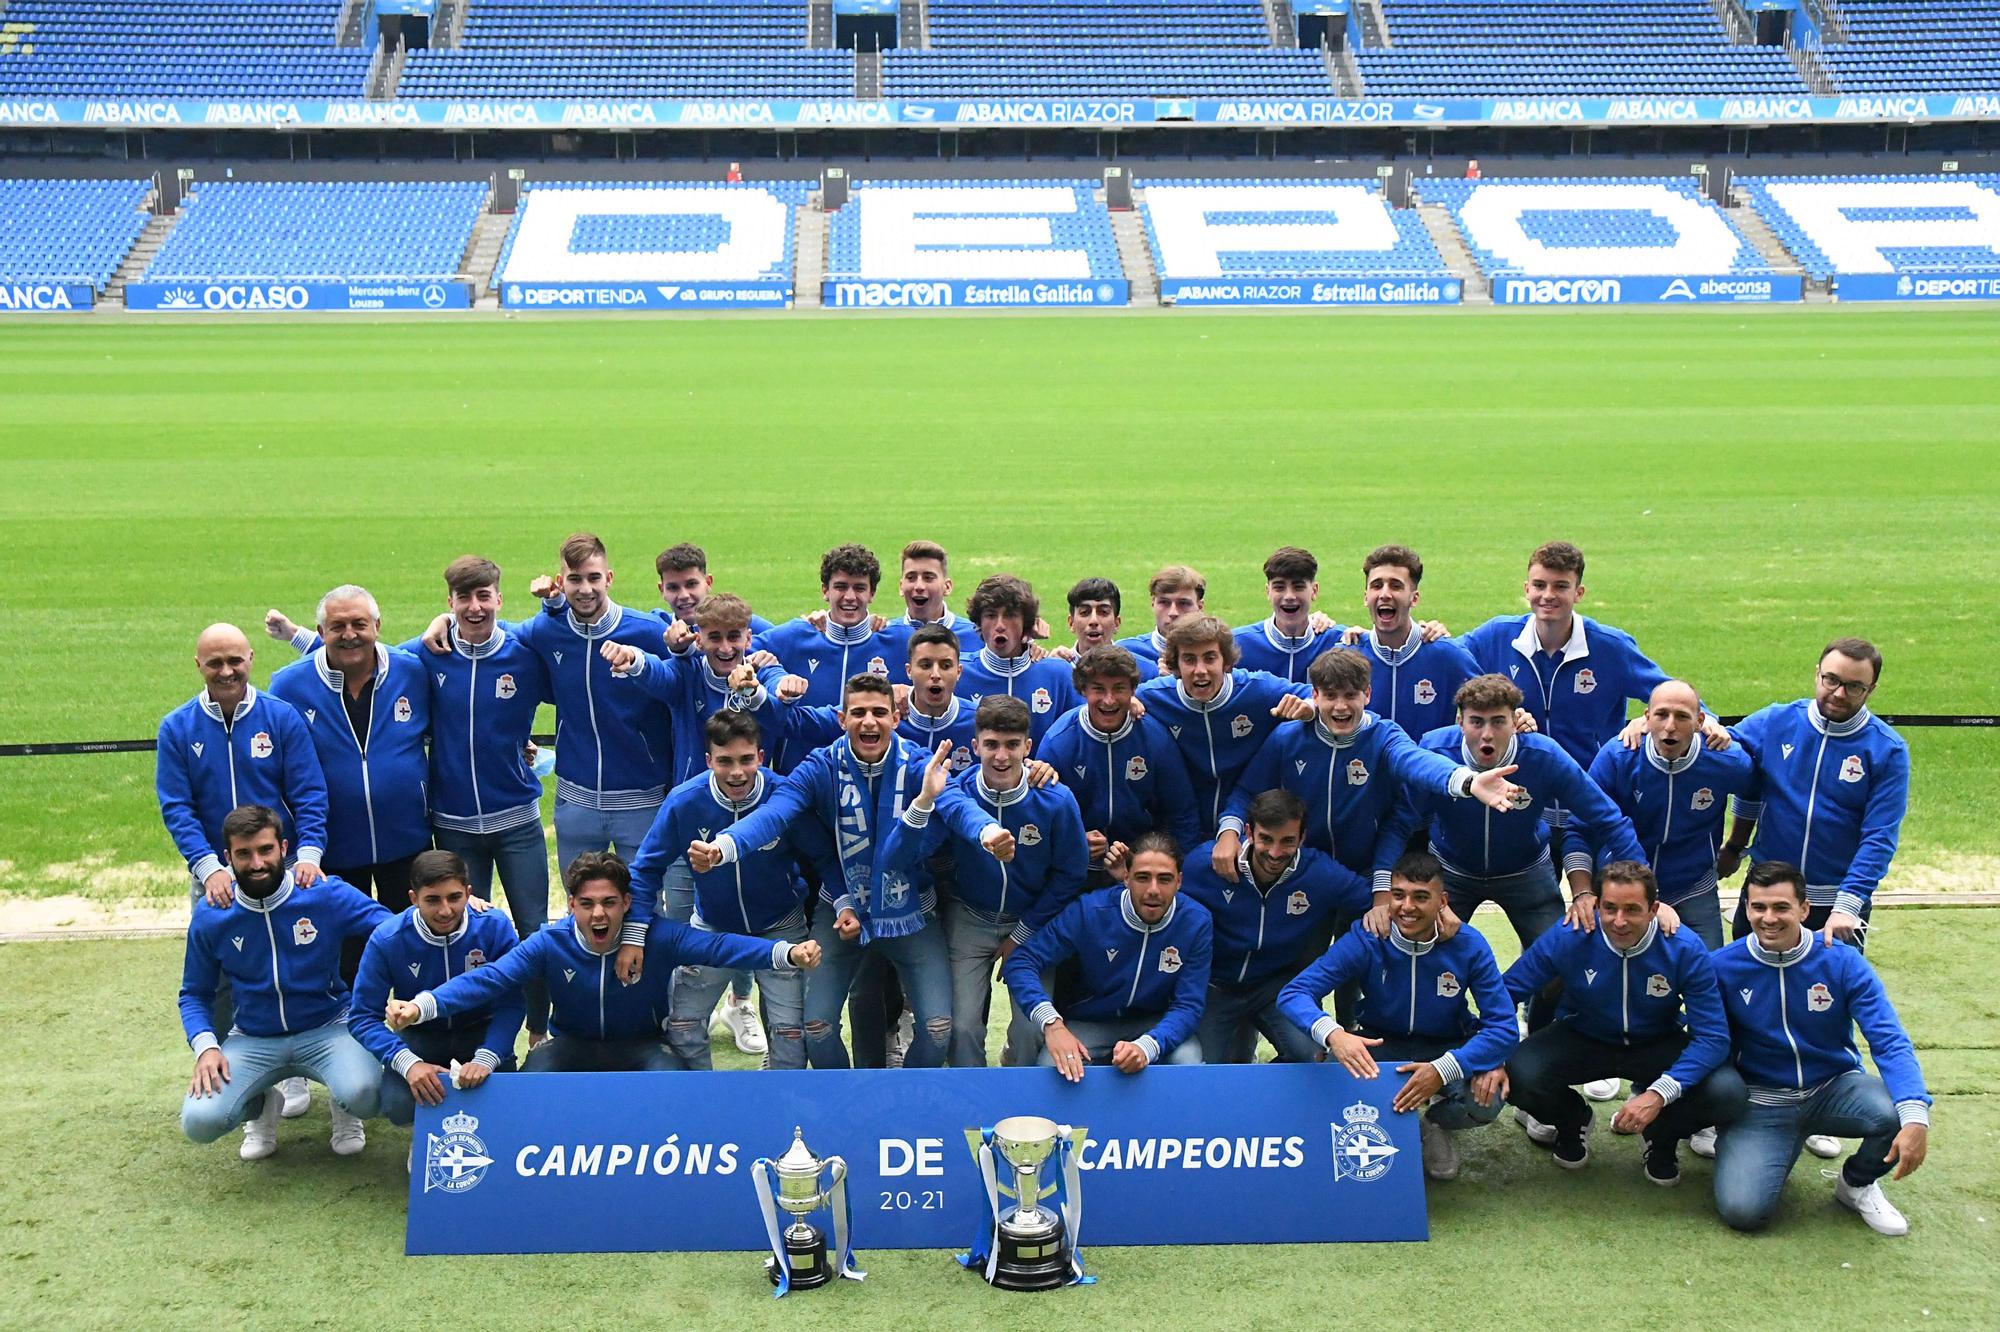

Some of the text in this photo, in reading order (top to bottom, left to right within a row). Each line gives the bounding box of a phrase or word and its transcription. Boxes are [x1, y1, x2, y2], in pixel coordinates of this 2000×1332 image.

[1052, 103, 1135, 121] RIAZOR
[1312, 103, 1393, 121] RIAZOR
[349, 285, 420, 297] Mercedes-Benz
[525, 288, 647, 304] DEPORTIENDA
[699, 289, 734, 301] GRUPO
[735, 289, 783, 301] REGUEIRA
[835, 283, 952, 306] macron
[963, 284, 1093, 303] Estrella Galicia
[1243, 285, 1301, 299] RIAZOR
[1311, 283, 1439, 302] Estrella Galicia
[1506, 279, 1620, 303] macron
[1700, 278, 1771, 295] abeconsa
[204, 286, 309, 309] OCASO
[1347, 1125, 1360, 1133] CLUB
[1361, 1124, 1387, 1143] DEPORTIVO
[444, 1135, 457, 1144] CLUB
[459, 1135, 483, 1154] DEPORTIVO
[516, 1133, 1305, 1177] CAMPIÓNS DE CAMPEONES
